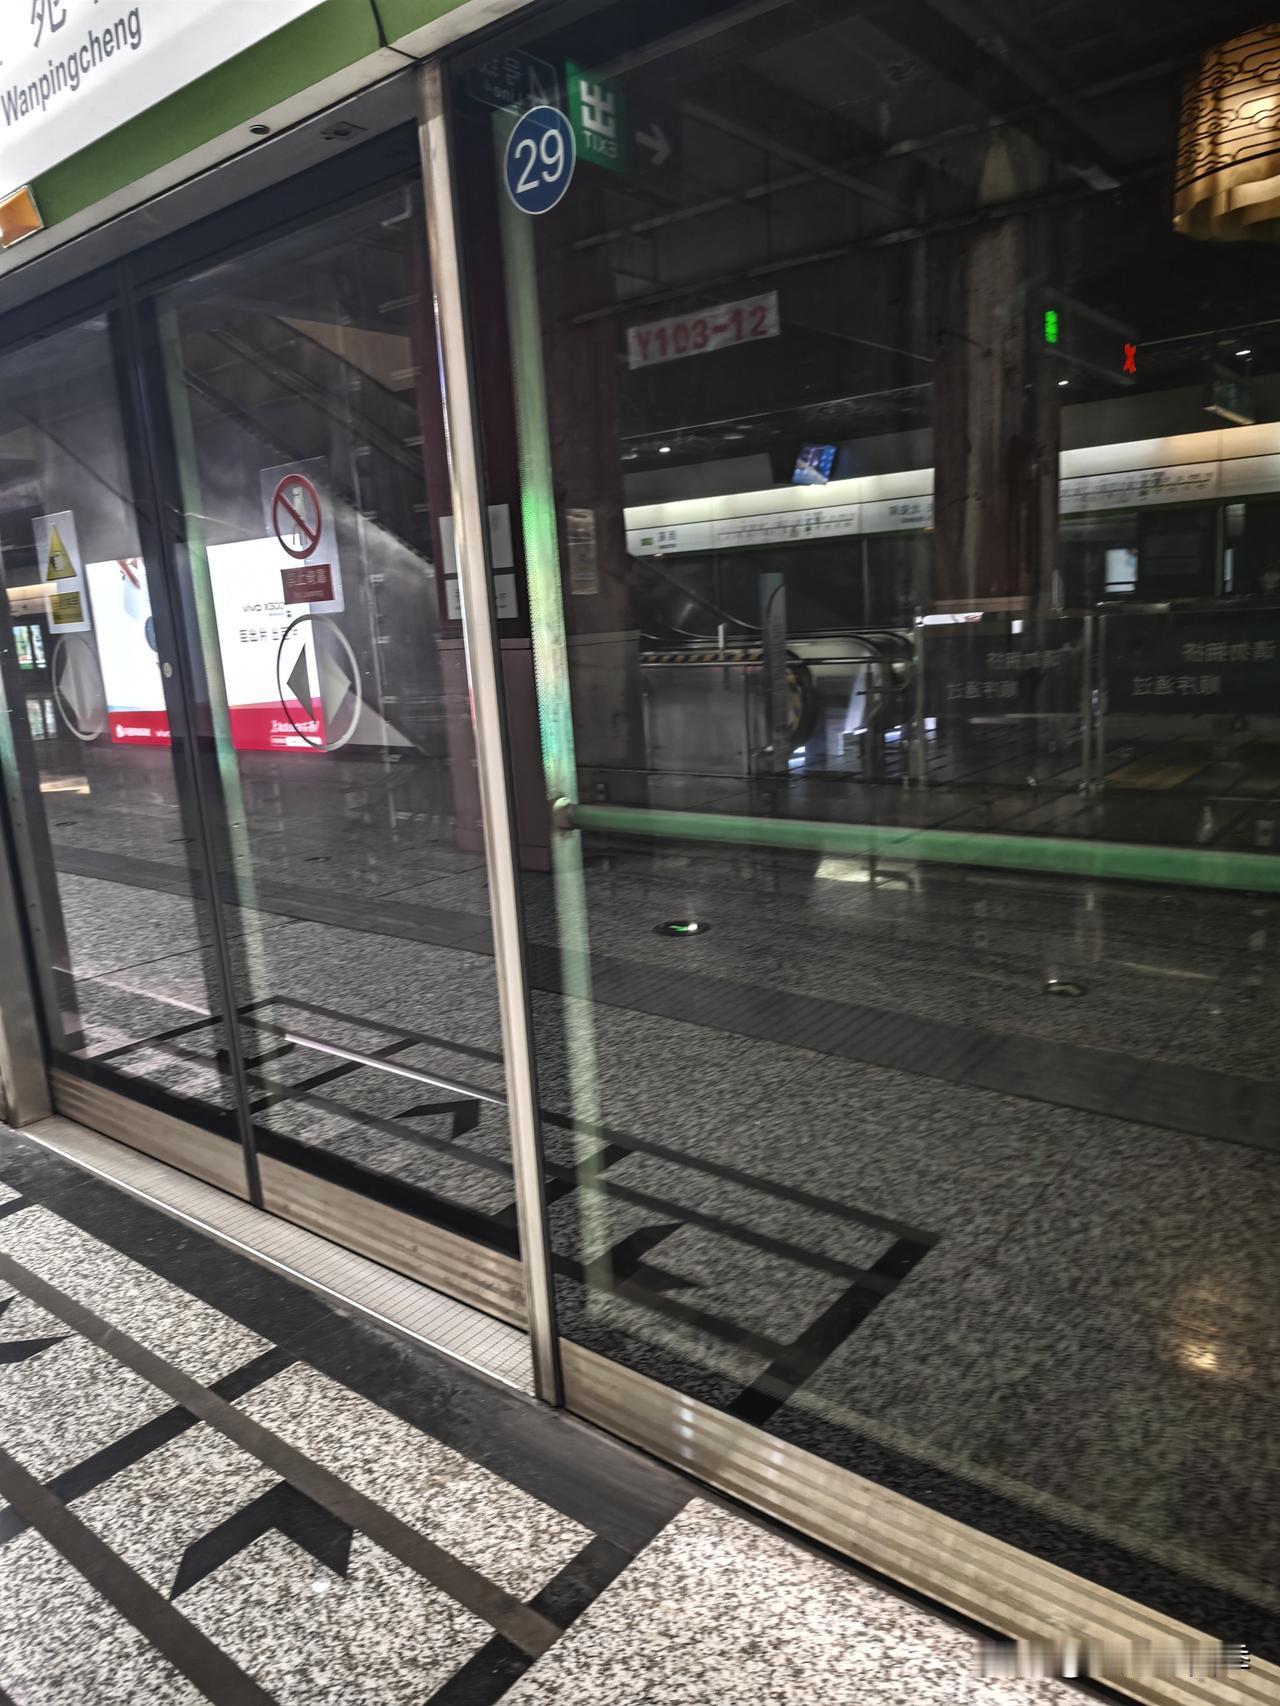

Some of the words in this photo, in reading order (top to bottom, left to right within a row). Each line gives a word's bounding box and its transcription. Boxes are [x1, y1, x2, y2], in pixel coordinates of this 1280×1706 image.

[1, 7, 142, 127] Wanpingcheng
[514, 128, 566, 194] 29
[633, 304, 769, 361] Y103-12
